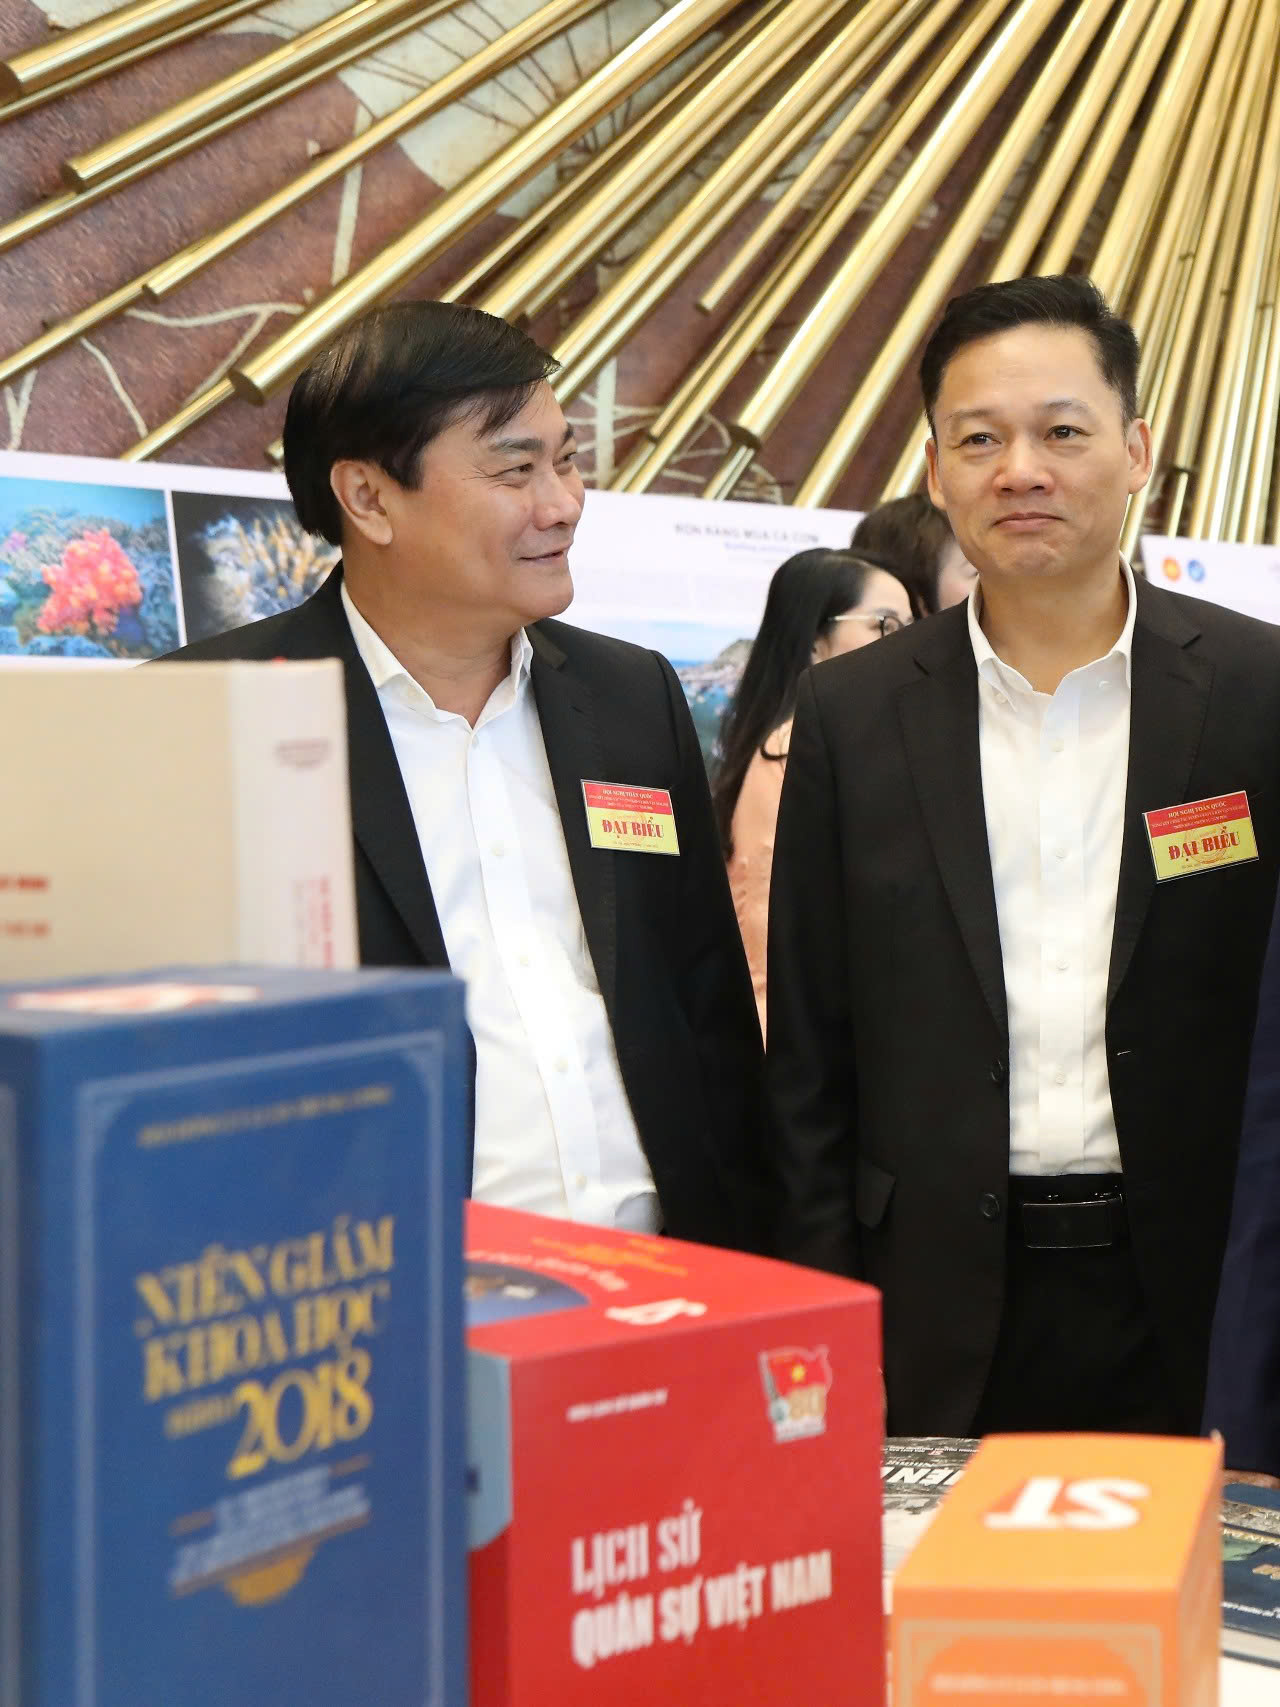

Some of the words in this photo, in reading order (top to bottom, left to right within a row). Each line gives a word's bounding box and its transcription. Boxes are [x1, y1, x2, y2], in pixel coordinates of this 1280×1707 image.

[602, 819, 628, 838] ĐẠI
[631, 816, 664, 838] BIỂU
[1168, 840, 1199, 862] ĐẠI
[1202, 826, 1240, 853] BIỂU
[1195, 803, 1211, 813] TOÀN
[134, 1243, 268, 1338] NIÊN
[269, 1212, 395, 1298] GIÁM
[143, 1311, 290, 1404] KHOA
[292, 1280, 390, 1358] HỌC
[226, 1346, 375, 1480] 2018
[572, 1522, 649, 1599] LỊCH
[657, 1497, 703, 1573] SỬ
[983, 1476, 1151, 1531] ST
[572, 1591, 655, 1669] QUÂN
[659, 1573, 703, 1646] SỰ
[705, 1560, 766, 1632] VIỆT
[771, 1549, 833, 1613] NAM
